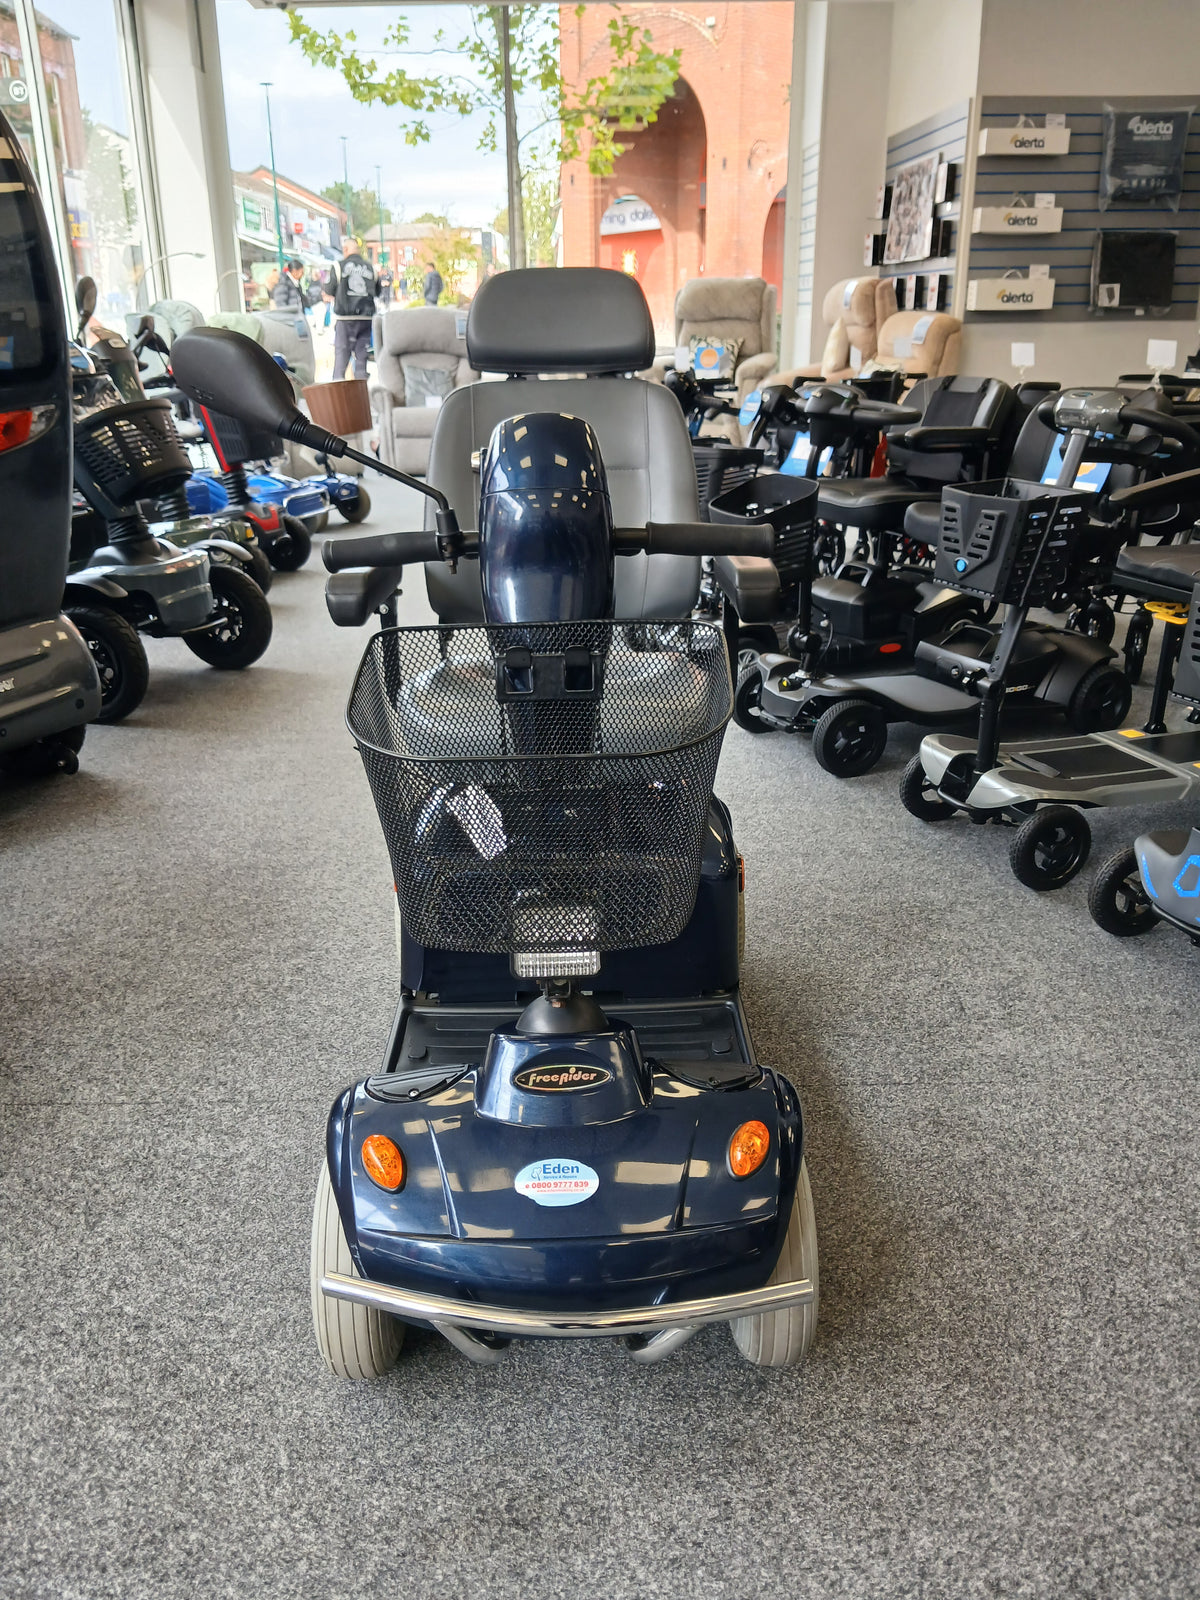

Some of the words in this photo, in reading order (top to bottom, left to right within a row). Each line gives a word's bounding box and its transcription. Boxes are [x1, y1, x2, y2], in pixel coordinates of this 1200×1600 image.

[1132, 119, 1174, 135] alerta
[1013, 136, 1046, 149] alerta
[1006, 214, 1039, 226] alerta
[1000, 291, 1034, 304] alerta
[542, 1163, 580, 1175] Eden
[574, 1180, 589, 1188] 839
